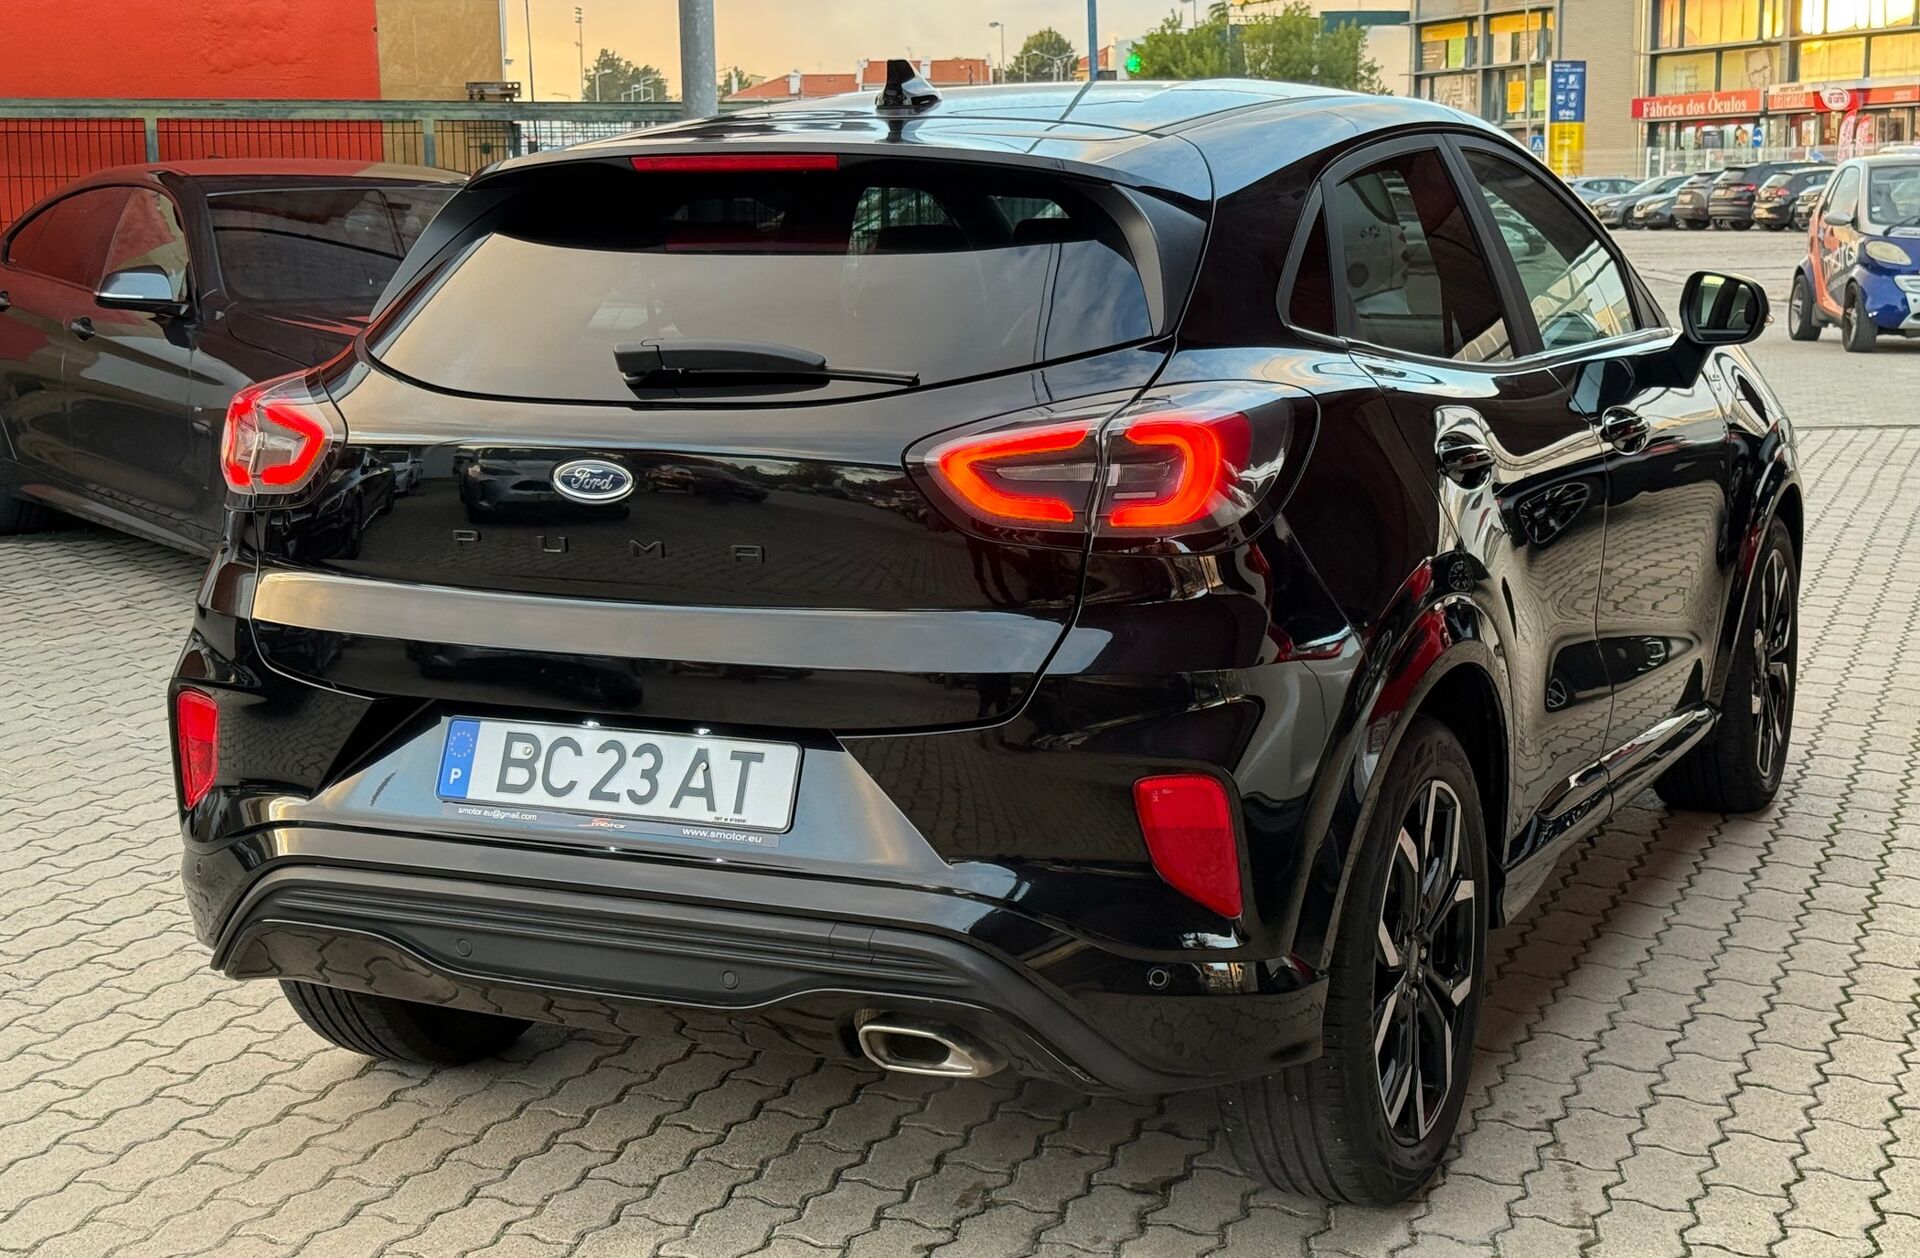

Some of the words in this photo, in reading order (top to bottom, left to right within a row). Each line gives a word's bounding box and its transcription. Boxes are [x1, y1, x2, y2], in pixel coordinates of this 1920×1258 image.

[1643, 99, 1683, 117] Fábrica
[1686, 99, 1704, 115] dos
[1708, 93, 1747, 114] Óculos
[571, 467, 614, 490] Ford
[452, 529, 766, 564] PUMA
[449, 769, 462, 785] P
[495, 731, 583, 798] BC
[588, 740, 664, 806] 23
[670, 748, 764, 815] AT
[458, 807, 537, 821] smotor.eu@gmail.com
[682, 828, 762, 843] www.smotor.eu
